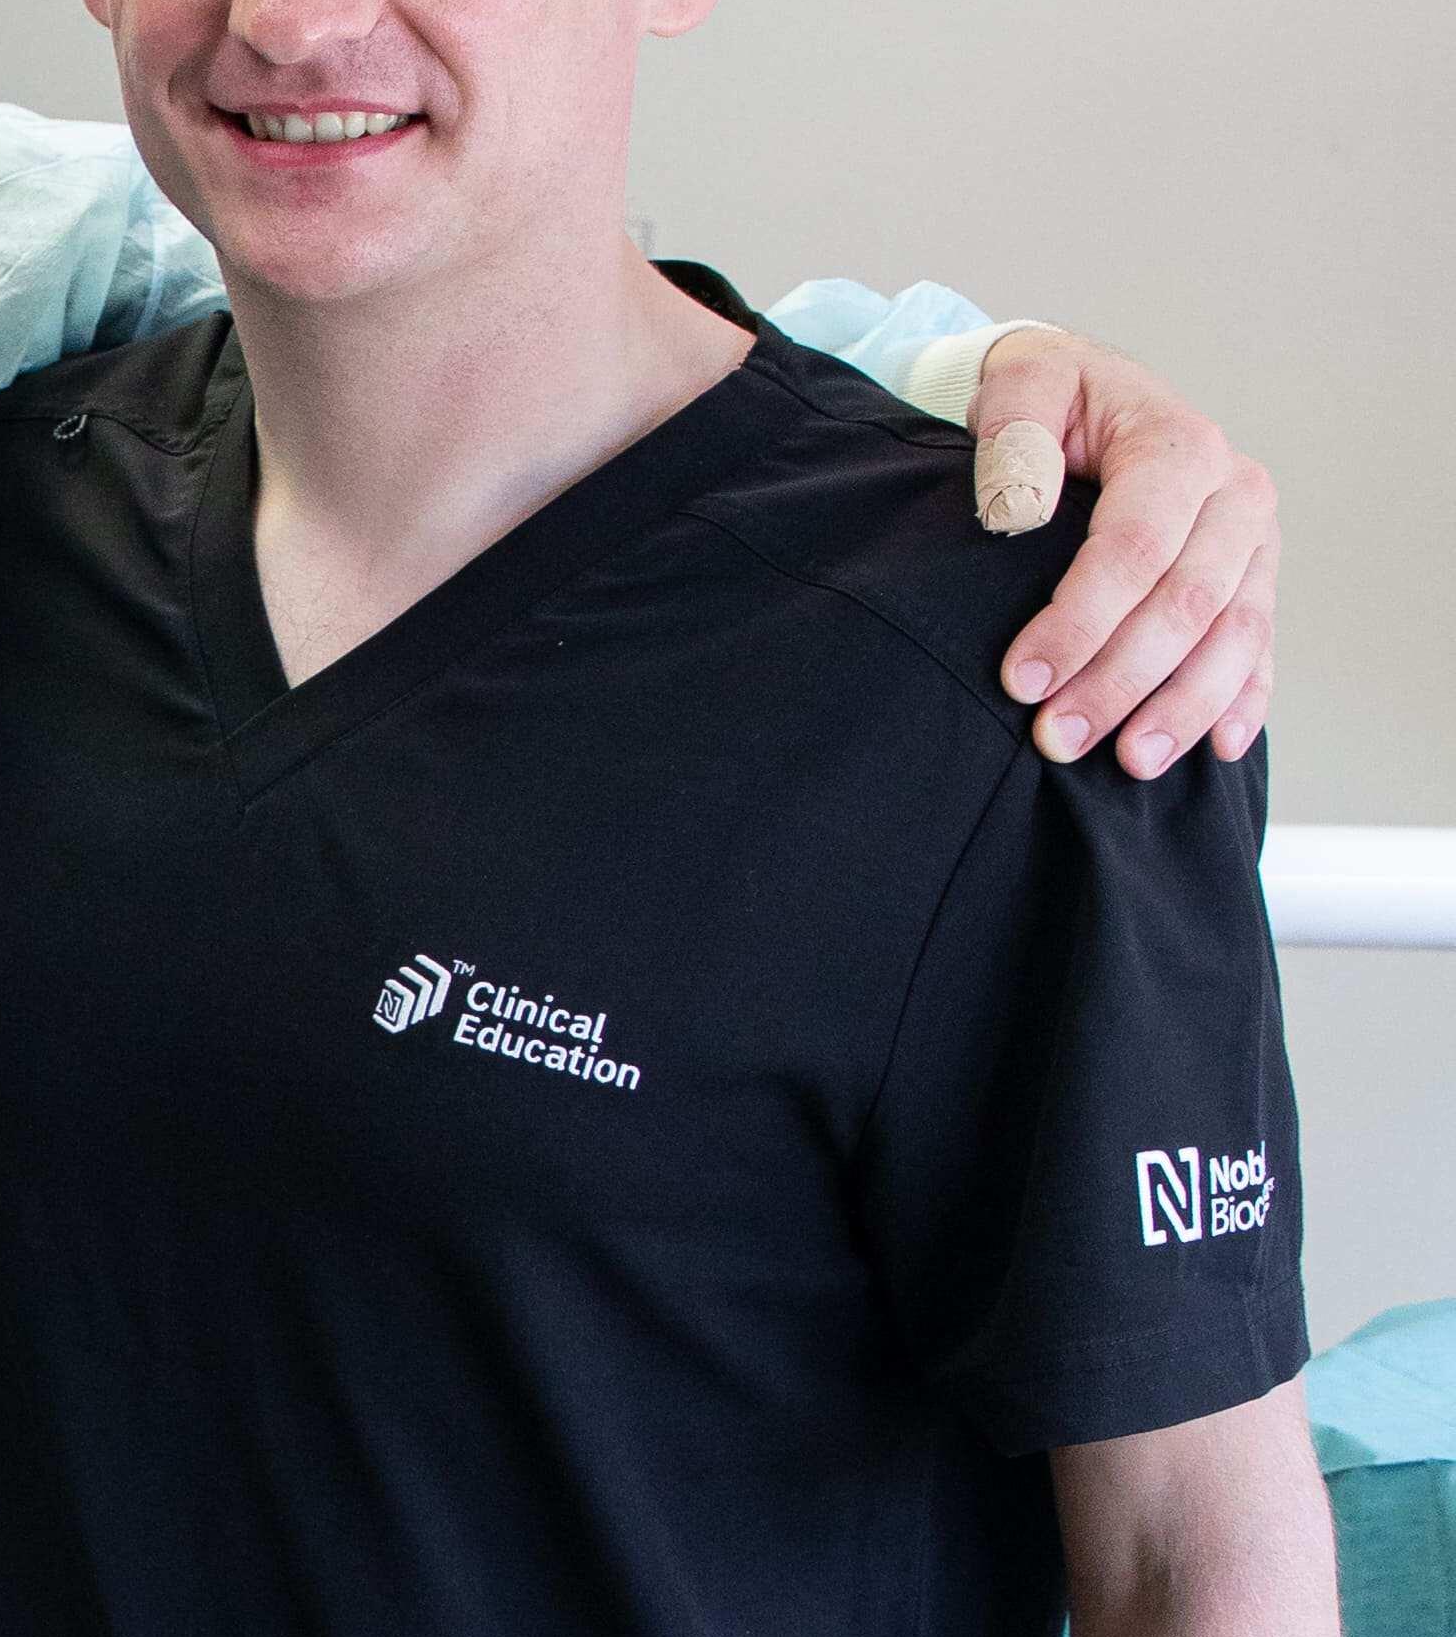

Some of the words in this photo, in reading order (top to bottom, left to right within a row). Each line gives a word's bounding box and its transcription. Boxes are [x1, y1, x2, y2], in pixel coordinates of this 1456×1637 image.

[466, 979, 607, 1044] Clinical
[452, 1013, 641, 1090] Education
[1209, 1140, 1266, 1194] Nob
